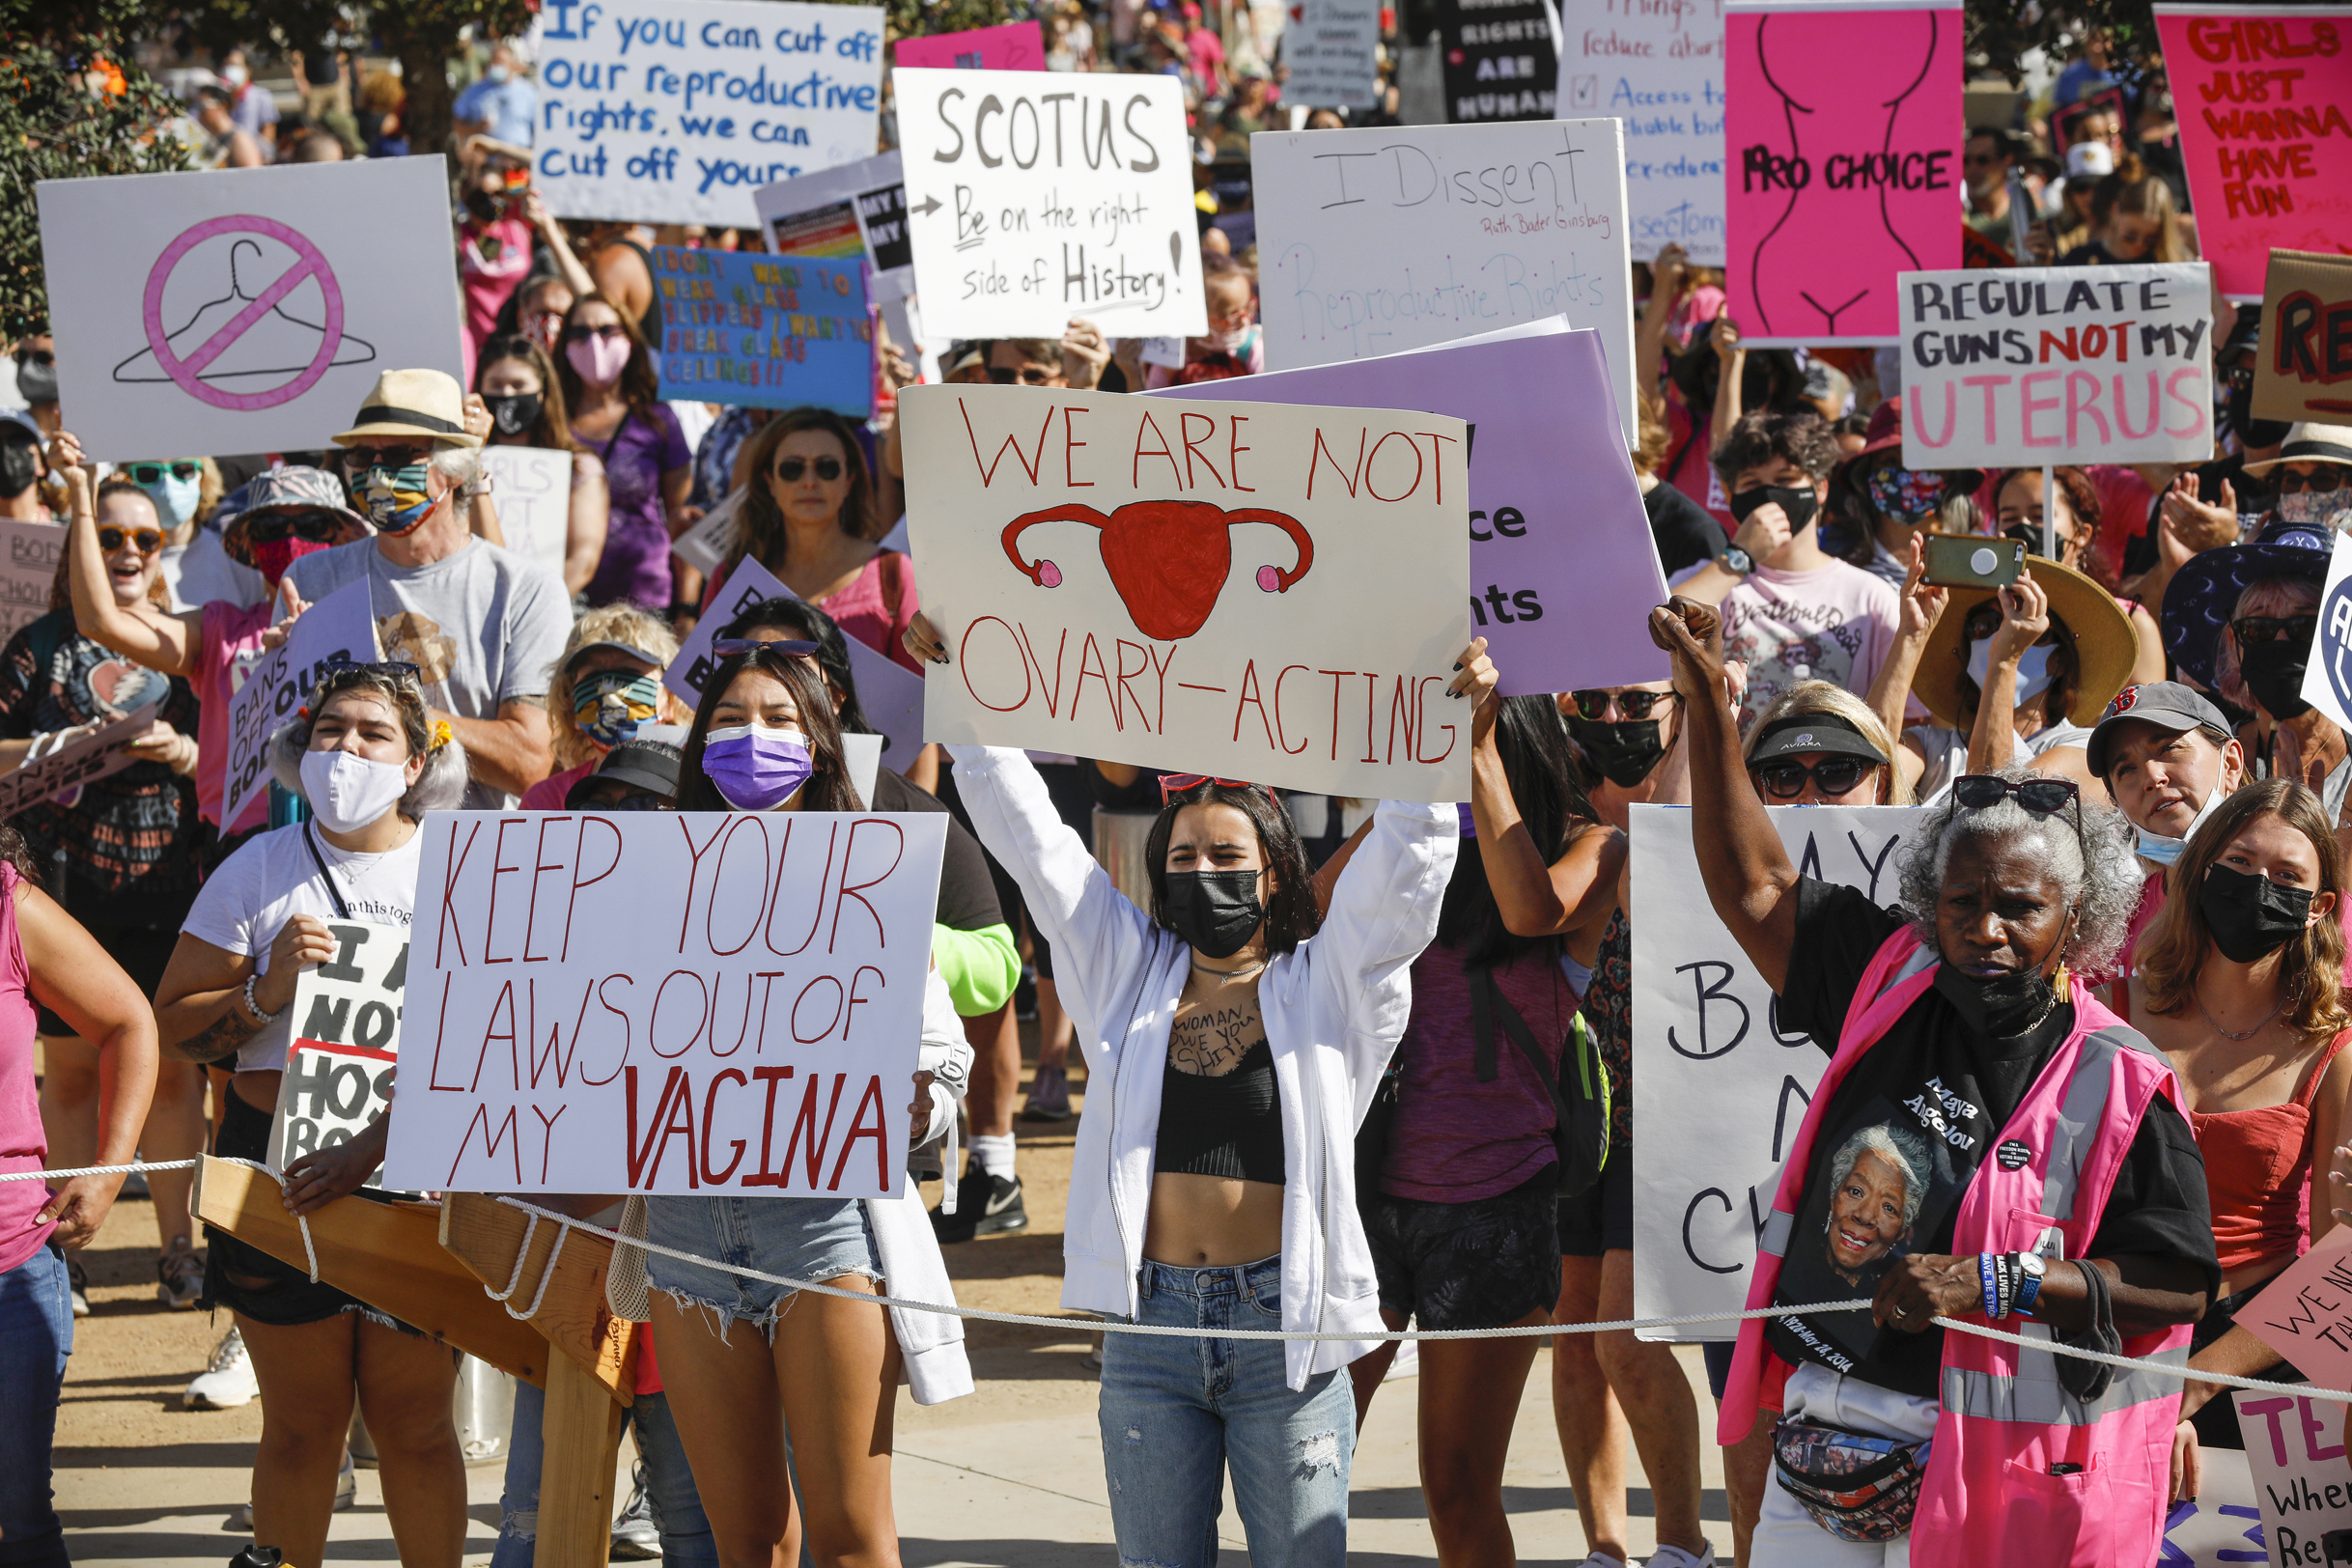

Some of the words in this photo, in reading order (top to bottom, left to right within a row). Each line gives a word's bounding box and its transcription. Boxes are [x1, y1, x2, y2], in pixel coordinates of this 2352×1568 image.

[544, 0, 602, 40] If
[617, 17, 686, 55] you
[775, 22, 826, 53] cut
[837, 31, 879, 63] off
[544, 58, 628, 91] our
[646, 64, 876, 112] reproductive
[1475, 55, 1536, 82] ARE
[1610, 76, 1693, 109] Access
[680, 114, 736, 139] we
[933, 87, 1161, 174] SCOTUS
[2201, 104, 2352, 142] WANNA
[626, 147, 680, 181] off
[1743, 144, 1811, 193] PRO
[1824, 150, 1953, 191] CHOICE
[2217, 144, 2317, 182] HAVE
[954, 183, 990, 241] Be
[1000, 206, 1030, 233] on
[1041, 186, 1078, 228] the
[1089, 191, 1150, 248] right
[1479, 213, 1513, 237] Ruth
[1511, 211, 1551, 235] Bader
[1554, 201, 1612, 240] Ginsburg
[2223, 181, 2295, 220] FUN
[659, 277, 716, 301] WEAR
[752, 262, 803, 288] WANT
[817, 267, 851, 297] TO
[961, 259, 1011, 301] side
[1022, 258, 1048, 295] of
[1911, 277, 2173, 322] REGULATE
[789, 313, 847, 340] WANT
[1912, 328, 2034, 368] GUNS
[2038, 320, 2138, 364] NOT
[2139, 319, 2208, 361] MY
[1909, 366, 2208, 451] UTERUS
[958, 397, 1095, 490] WE
[1133, 410, 1256, 493] ARE
[1304, 425, 1458, 506] NOT
[235, 647, 289, 741] BANS
[232, 700, 272, 774] OFF
[1780, 742, 1822, 750] AVIARA
[358, 900, 387, 915] this
[434, 814, 624, 969] KEEP
[678, 813, 905, 957] YOUR
[317, 924, 370, 984] I
[429, 970, 634, 1093] LAWS
[649, 968, 785, 1058] OUT
[791, 966, 886, 1045] OF
[1172, 1004, 1244, 1031] WOMAN
[1216, 1016, 1255, 1048] YOU
[1924, 1076, 1979, 1119] Maya
[446, 1103, 568, 1188] MY
[624, 1065, 889, 1192] VAGINA
[1902, 1094, 1976, 1151] Angelou
[1984, 1279, 1994, 1293] BE
[1998, 1274, 2009, 1299] LIVES
[2264, 1285, 2340, 1335] WE
[1826, 1353, 1854, 1373] 2014
